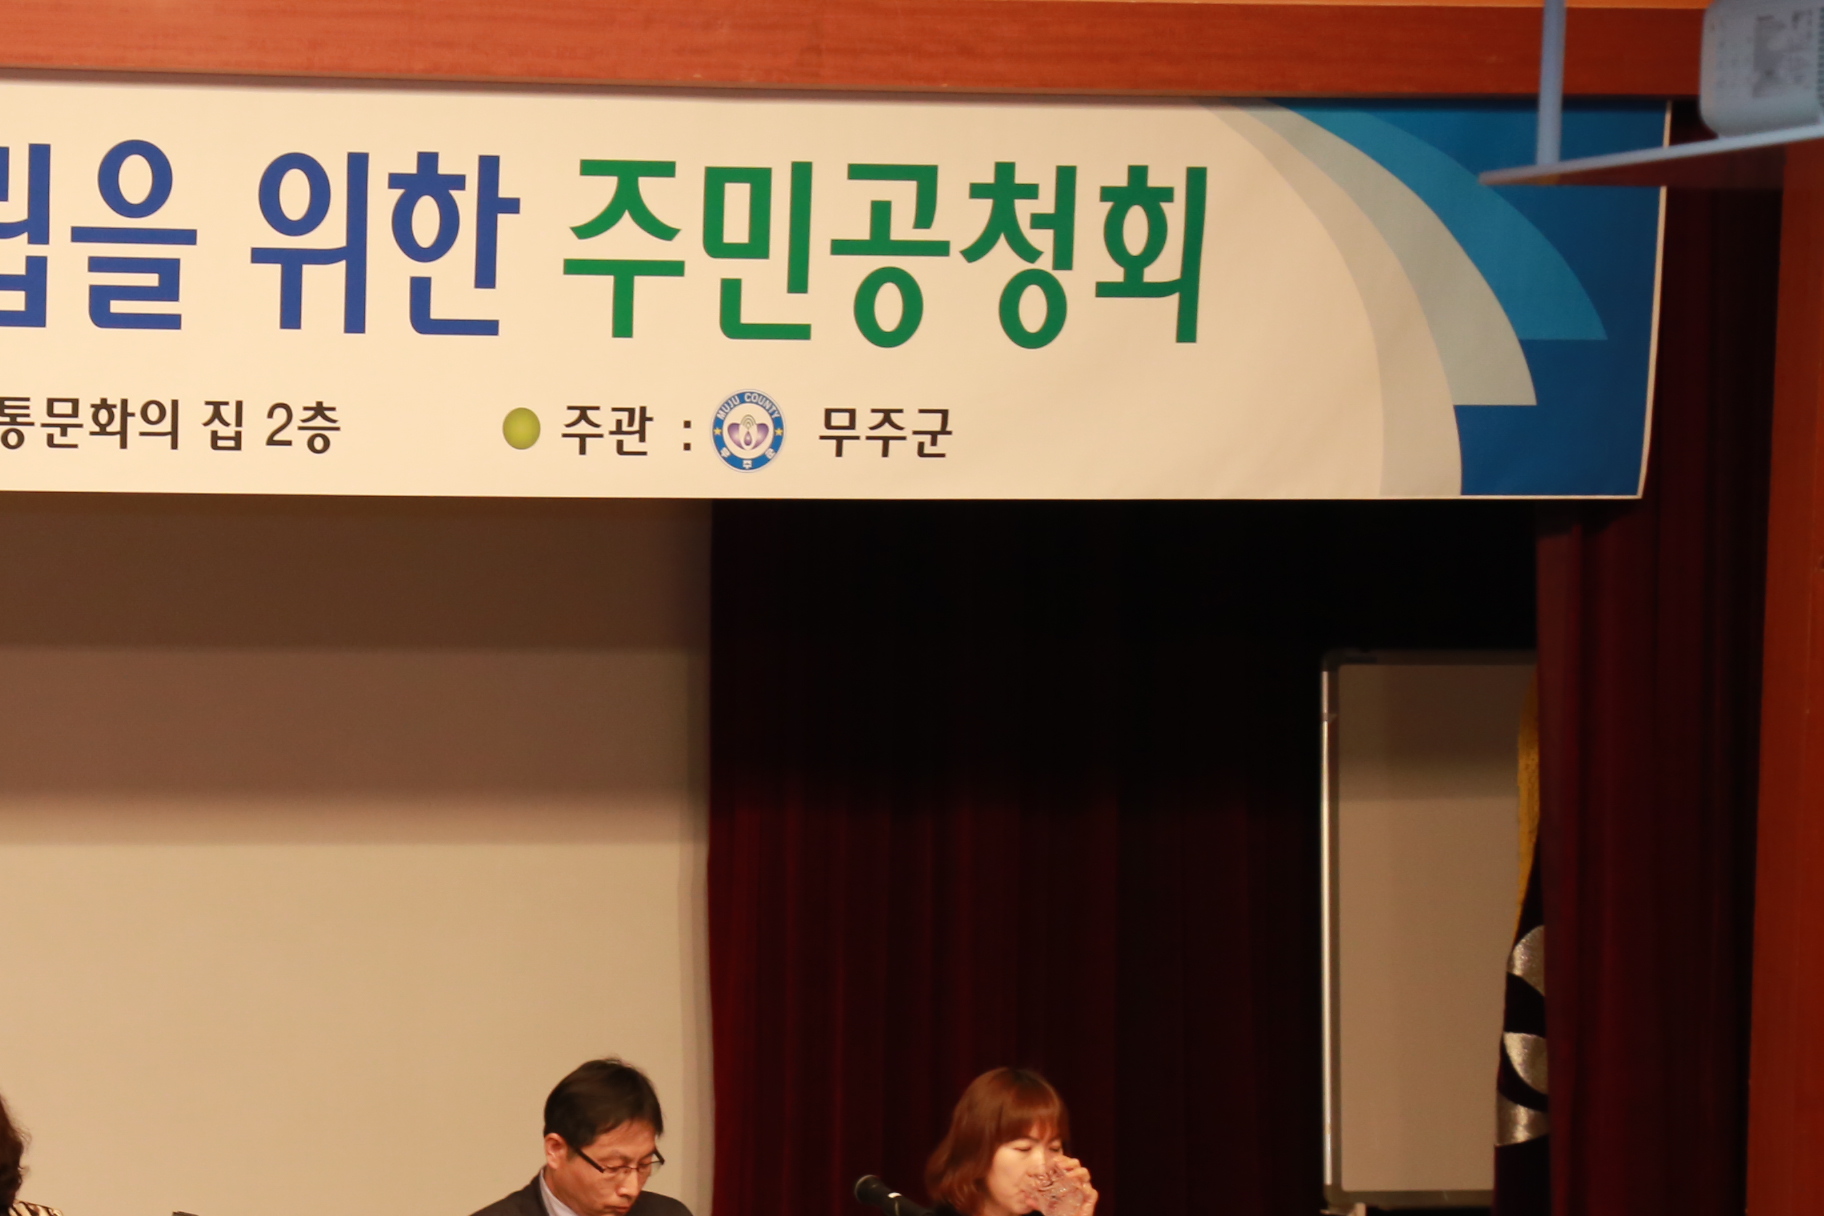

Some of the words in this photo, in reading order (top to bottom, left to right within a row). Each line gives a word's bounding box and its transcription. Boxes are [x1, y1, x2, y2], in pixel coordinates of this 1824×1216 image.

[250, 151, 521, 337] 위한
[563, 159, 1208, 350] 주민공청회
[202, 399, 244, 452] 집
[265, 400, 341, 455] 2층
[561, 405, 654, 457] 주관
[716, 395, 740, 420] MUJU
[744, 392, 780, 418] COUNTY
[818, 407, 953, 459] 무주군
